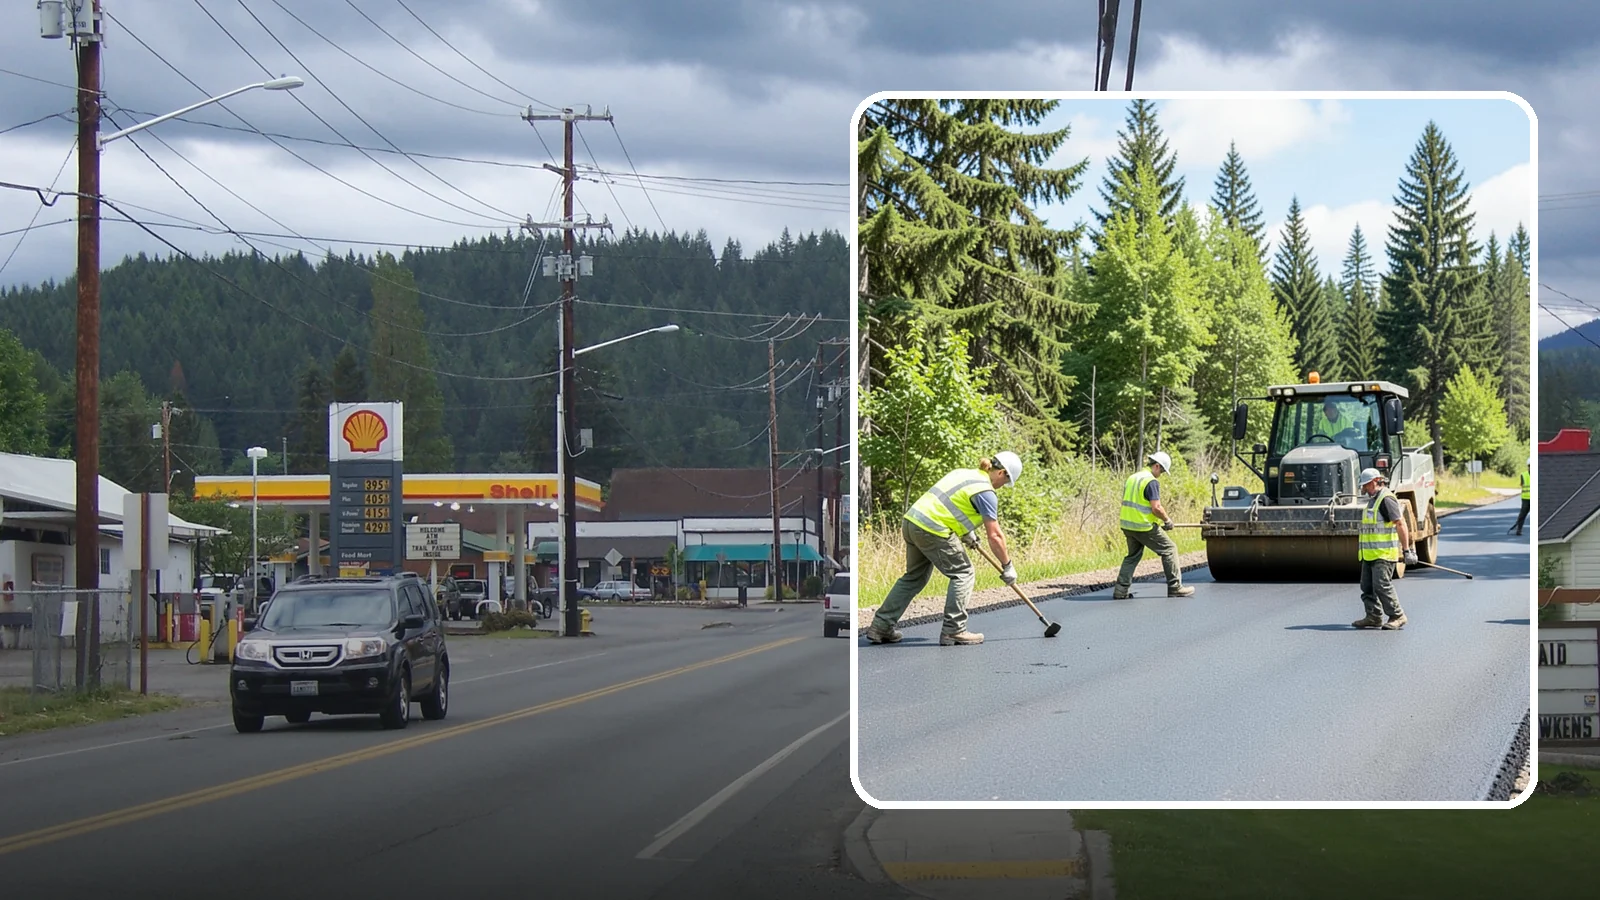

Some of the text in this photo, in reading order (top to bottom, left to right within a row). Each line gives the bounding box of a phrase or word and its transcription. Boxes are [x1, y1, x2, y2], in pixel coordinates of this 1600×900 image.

[366, 480, 383, 490] 395
[490, 484, 547, 499] Shell
[366, 494, 383, 504] 405
[366, 508, 383, 518] 415
[366, 522, 383, 532] 429
[1538, 643, 1566, 665] AID
[1538, 716, 1592, 738] WKENS
